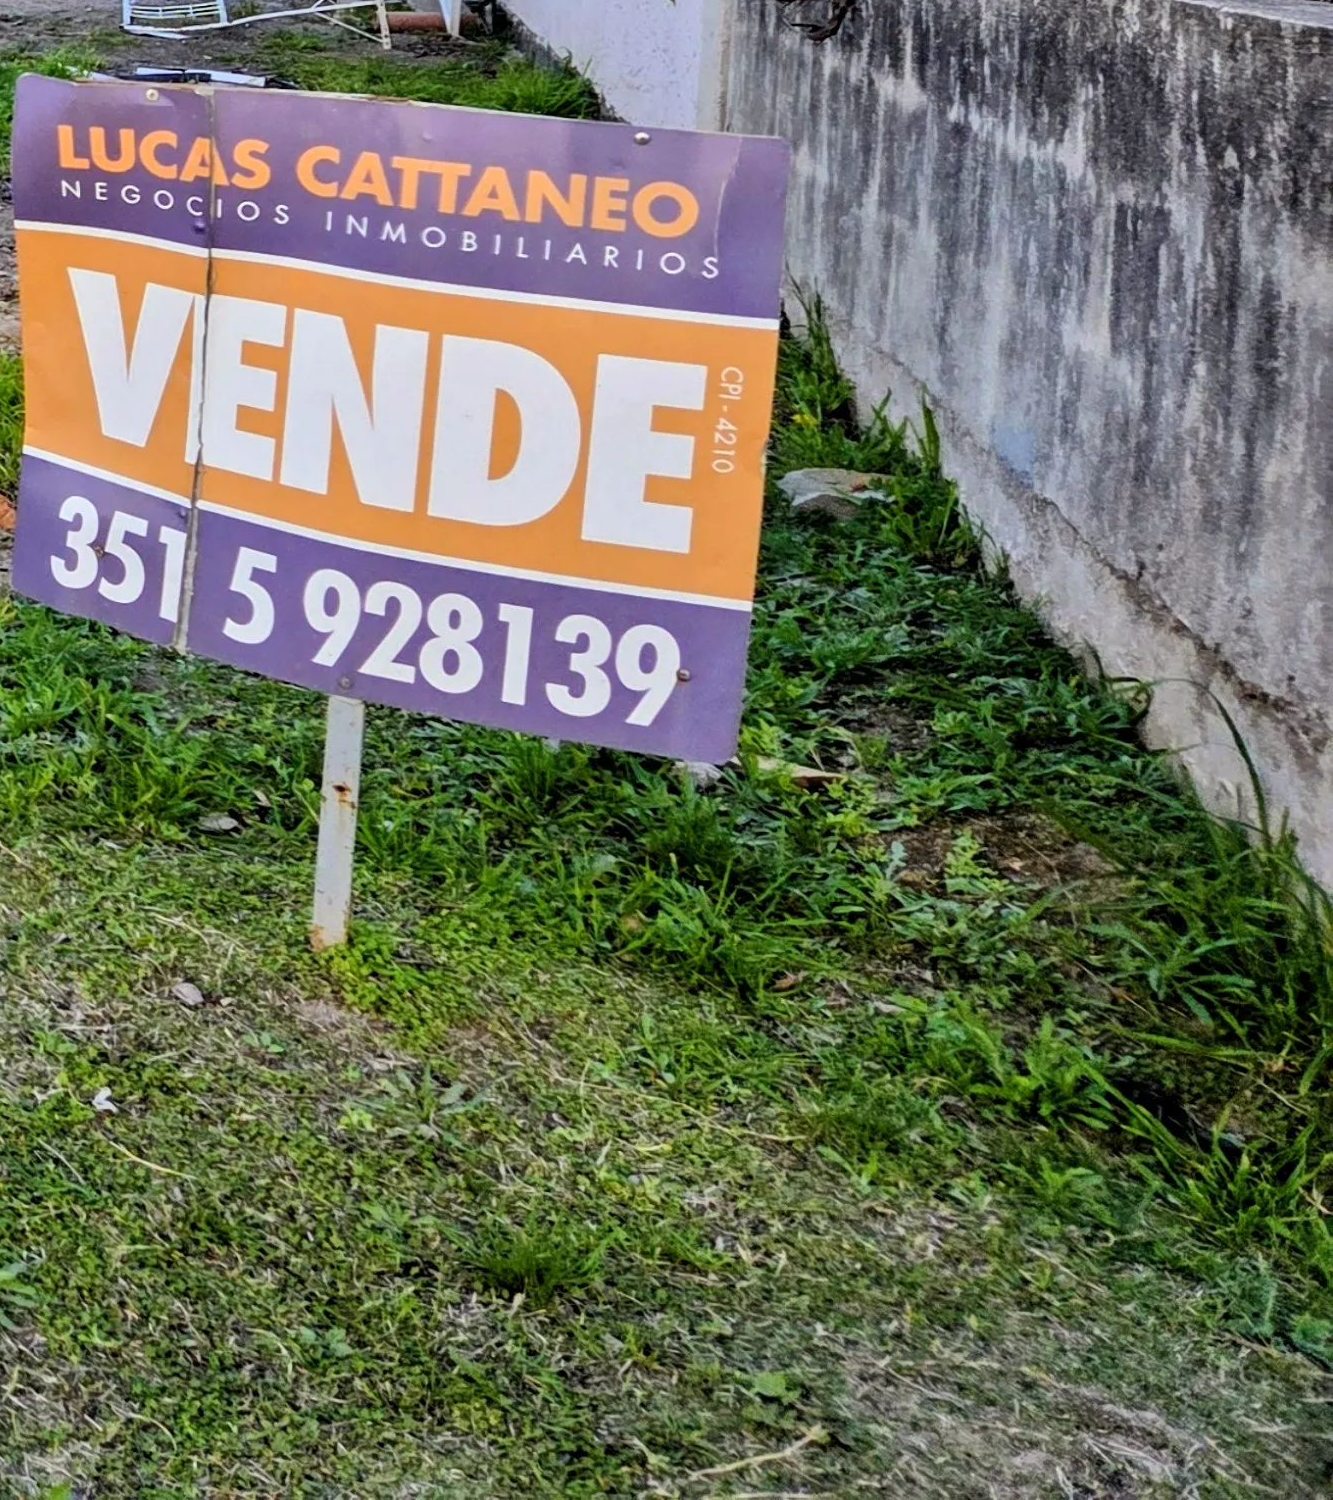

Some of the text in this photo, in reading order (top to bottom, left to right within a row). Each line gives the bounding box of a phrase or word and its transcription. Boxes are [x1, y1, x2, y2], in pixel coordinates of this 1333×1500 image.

[56, 124, 700, 238] LUCAS CATTANEO
[61, 180, 719, 280] NEGOCIOS INMOBILIARIOS
[67, 267, 708, 554] VENDE
[718, 366, 744, 400] CPI
[711, 417, 738, 473] 4210
[50, 496, 681, 726] 351 5 928139
